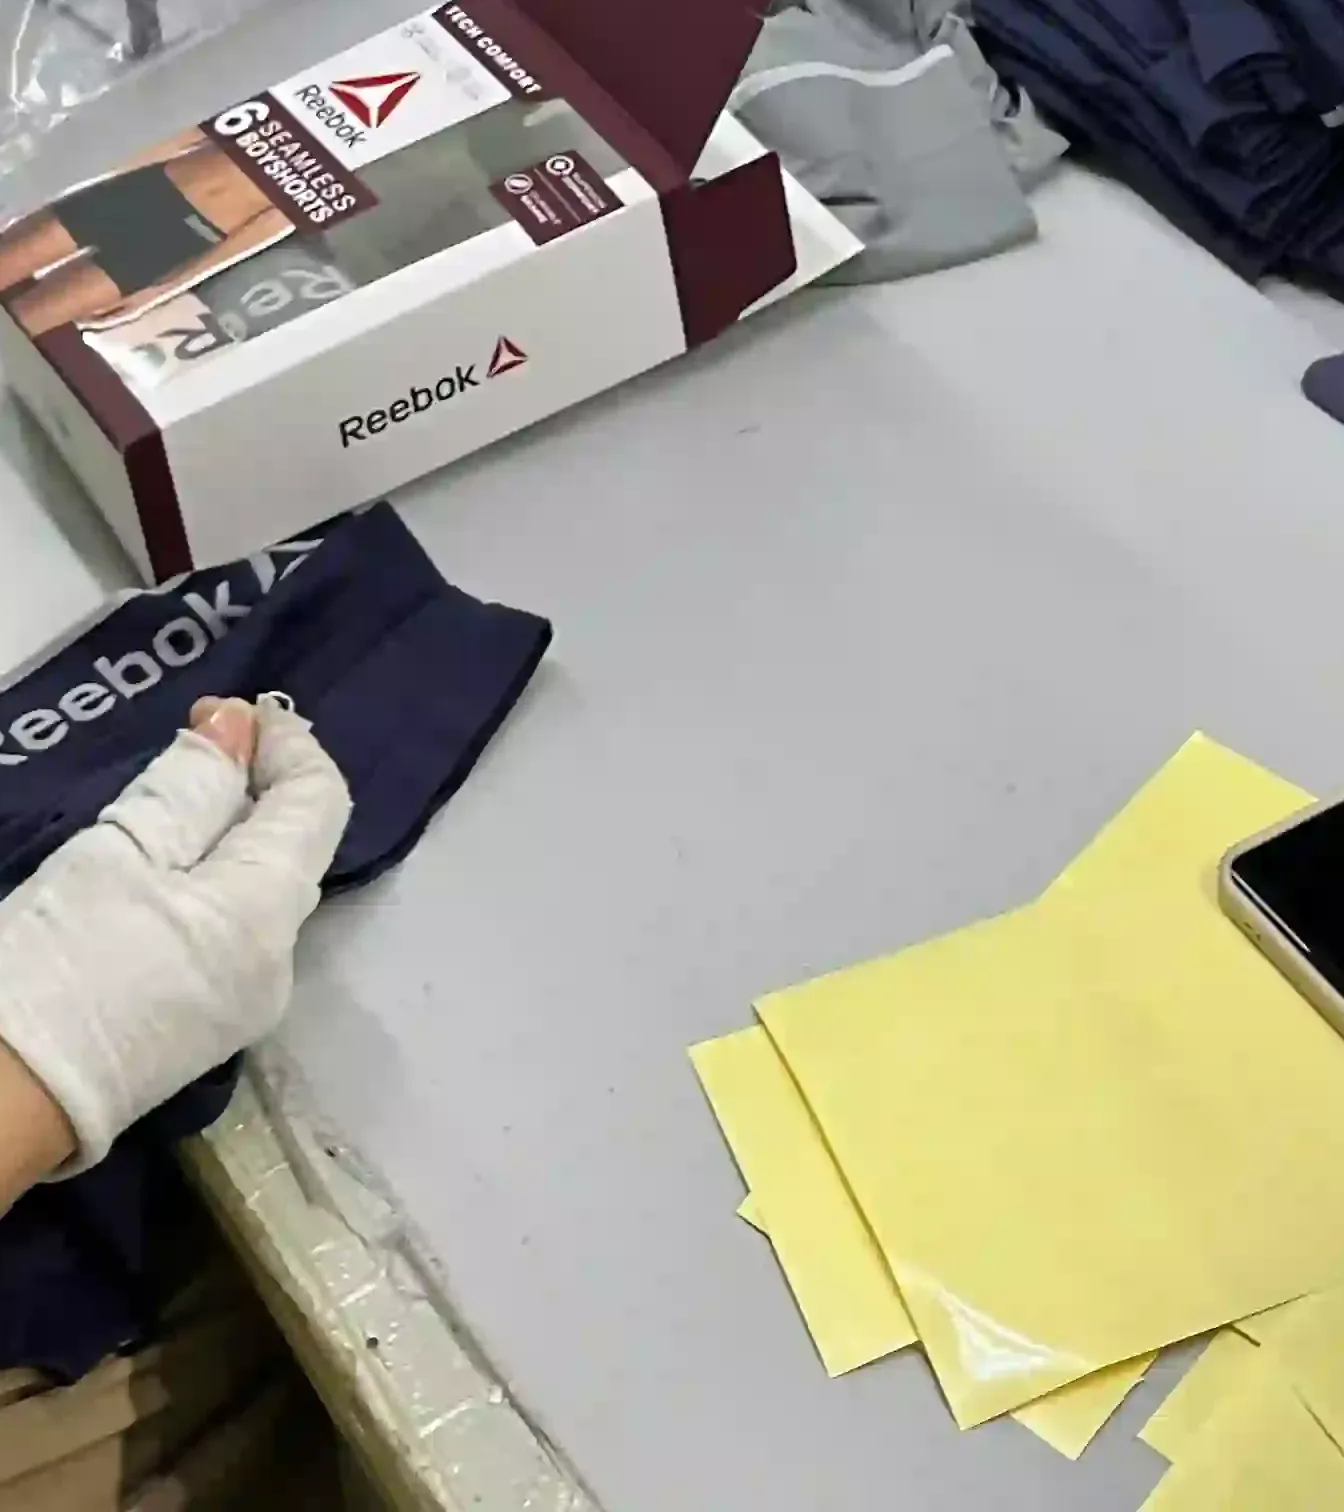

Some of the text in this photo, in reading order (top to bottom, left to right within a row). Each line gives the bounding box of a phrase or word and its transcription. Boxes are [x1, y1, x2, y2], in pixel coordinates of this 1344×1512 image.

[444, 5, 484, 39] TECH
[477, 34, 542, 95] COMFORT
[213, 100, 270, 136] 6
[295, 83, 369, 149] Reebok
[235, 130, 335, 224] BOYSHORTS
[258, 119, 357, 213] SEAMLESS
[338, 363, 481, 449] Reebok
